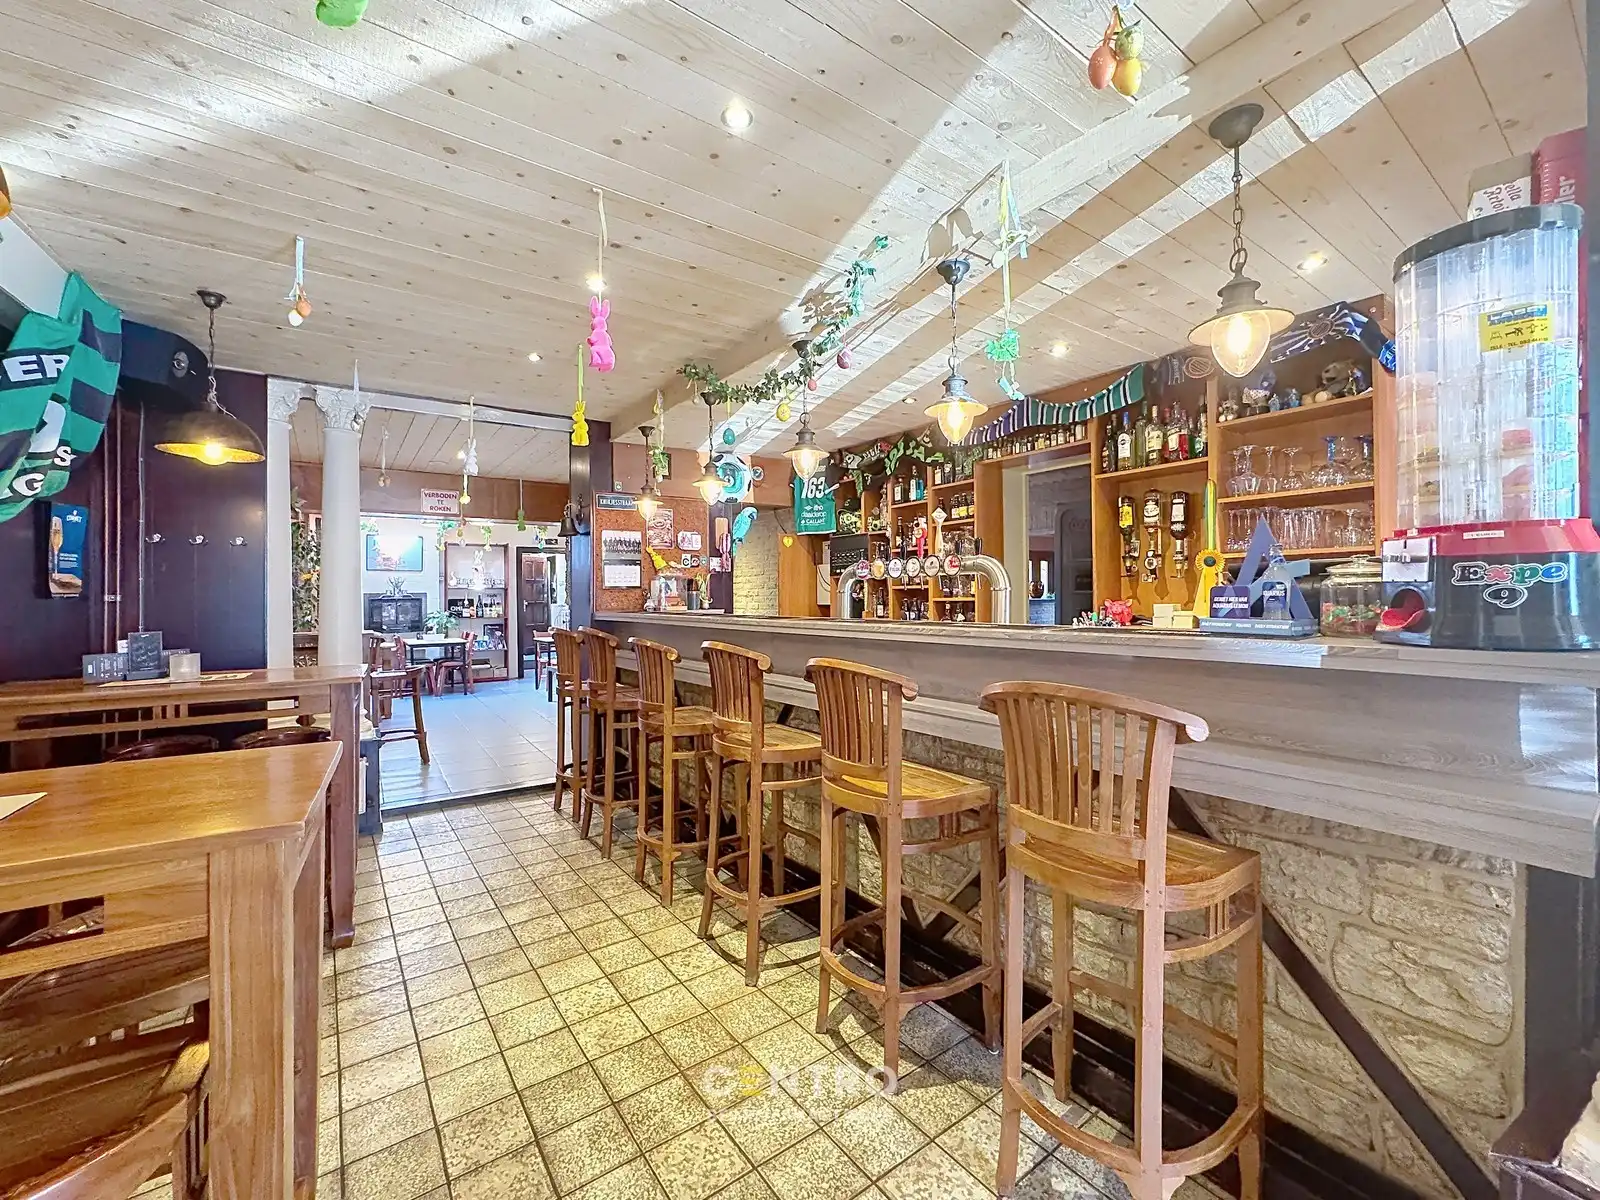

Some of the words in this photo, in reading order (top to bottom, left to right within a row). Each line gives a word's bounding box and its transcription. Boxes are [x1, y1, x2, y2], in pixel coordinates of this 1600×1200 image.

[1483, 187, 1510, 213] Artoi
[424, 491, 457, 499] VERBODEN
[801, 476, 825, 499] 163
[1451, 561, 1569, 586] Expe
